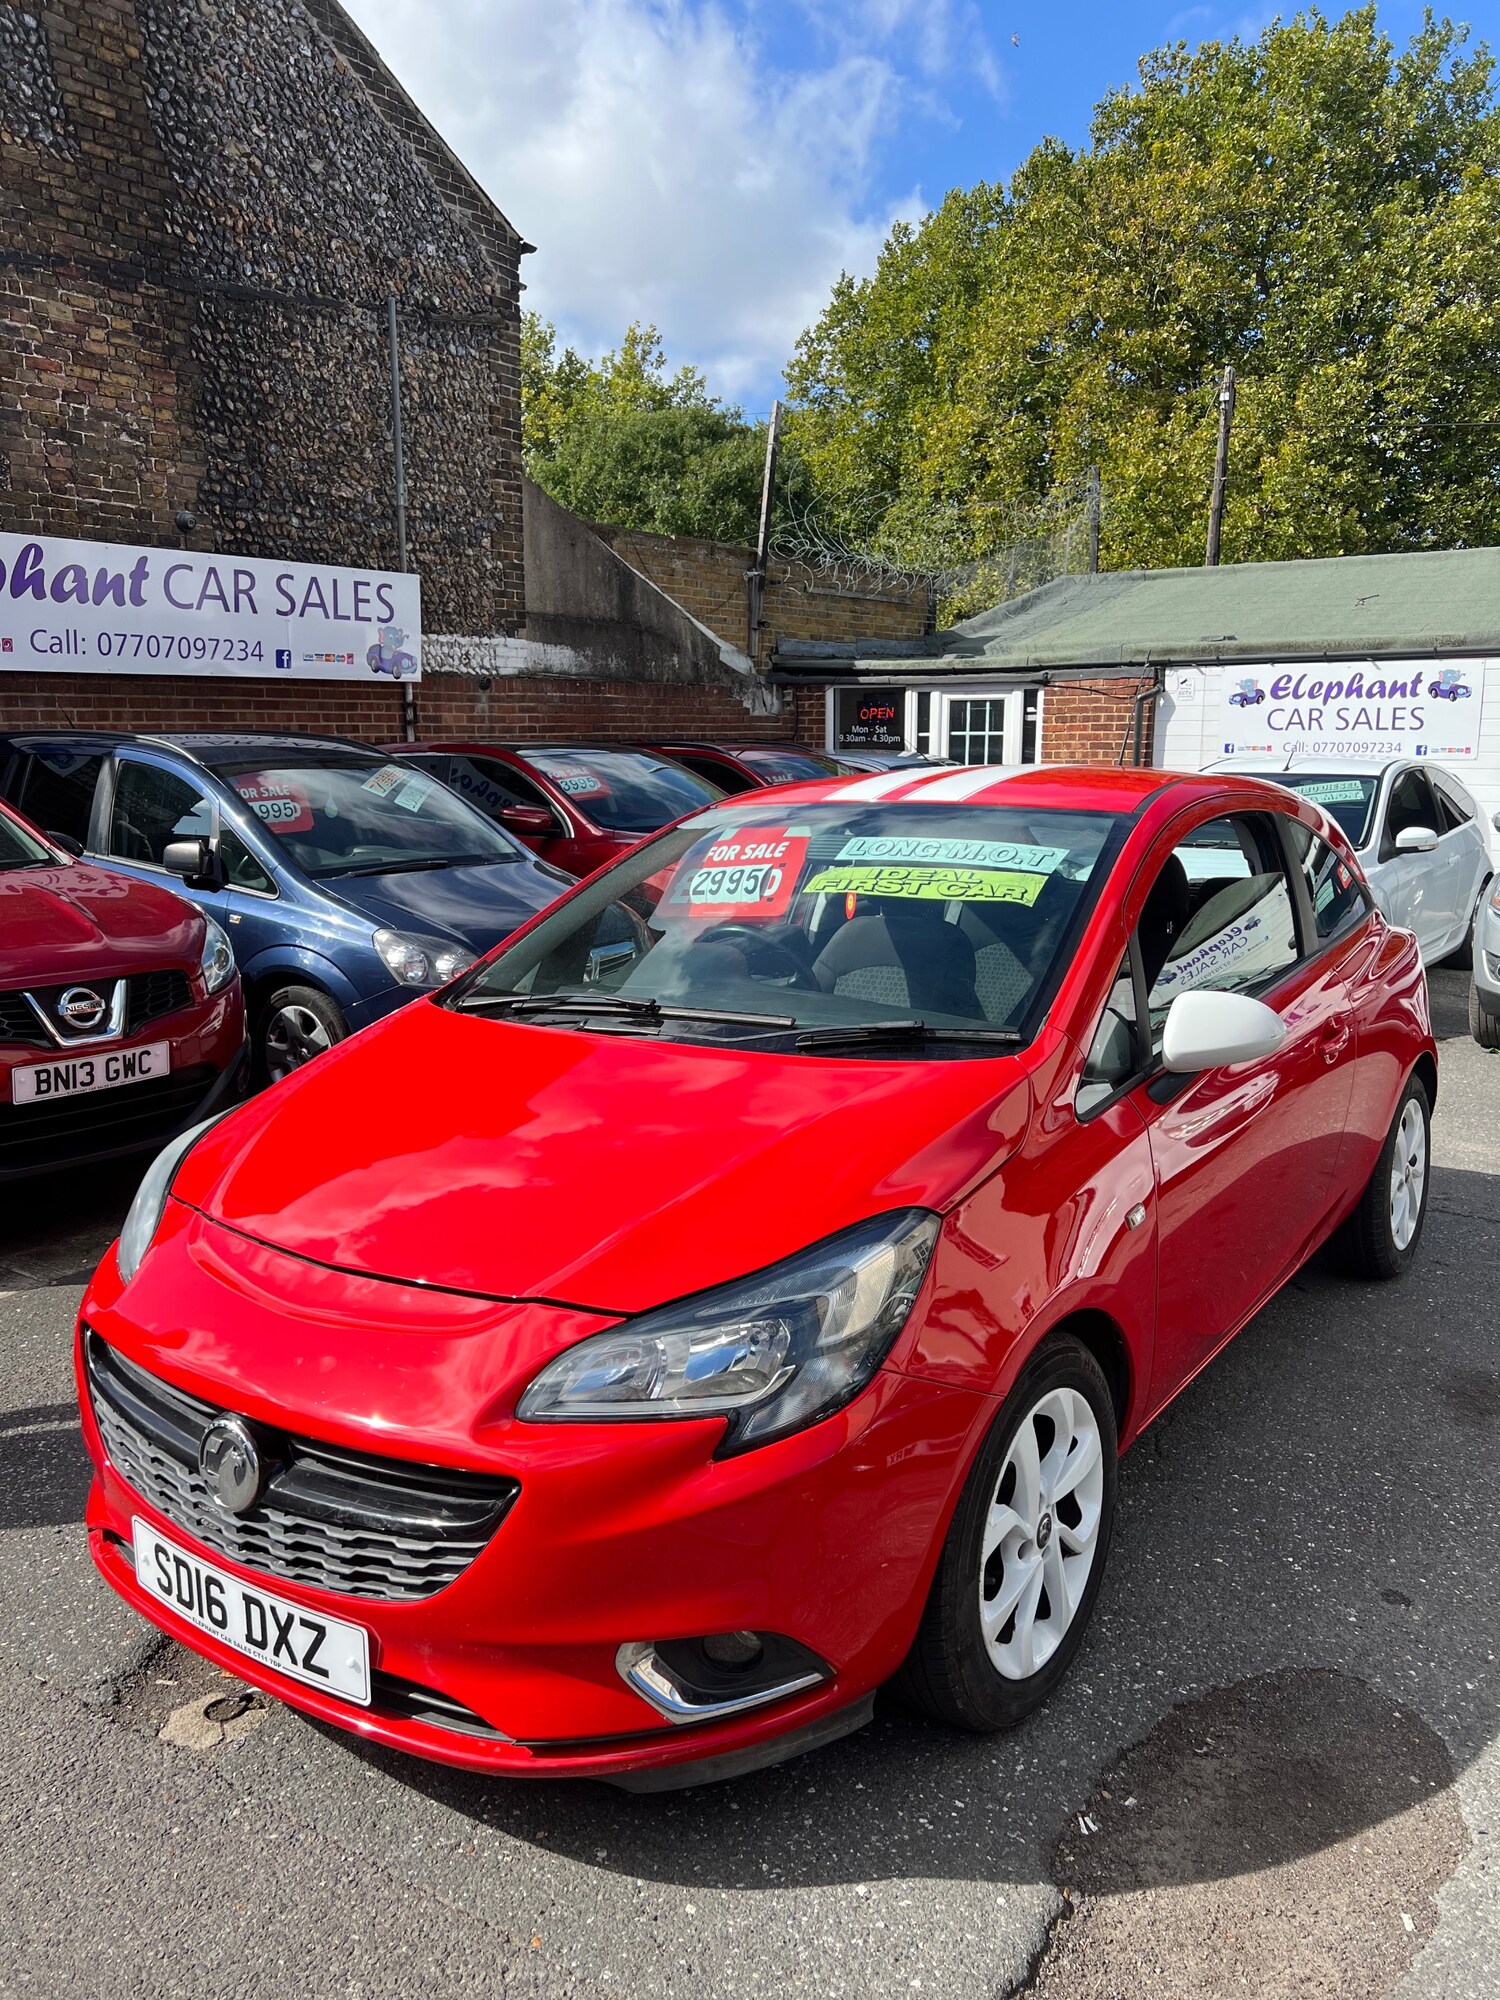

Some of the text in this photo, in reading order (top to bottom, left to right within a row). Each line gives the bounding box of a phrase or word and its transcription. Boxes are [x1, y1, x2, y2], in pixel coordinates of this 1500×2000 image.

[0, 543, 395, 623] hant CAR SALES
[29, 628, 264, 662] Call: 07707097234
[1269, 671, 1423, 706] Elephant
[860, 707, 895, 719] OPEN
[1267, 707, 1425, 731] CAR SALES
[839, 734, 866, 742] 9.30am
[872, 734, 901, 744] 4.30pm
[851, 725, 869, 733] Mon
[875, 725, 888, 733] Sat
[1313, 741, 1402, 753] 07707097234
[560, 777, 596, 791] 3995
[773, 774, 794, 782] SALE
[235, 785, 290, 798] OR SALE
[704, 842, 791, 862] FOR SALE
[848, 838, 1056, 867] LONG M.O.T
[865, 868, 983, 884] IDEAL
[815, 879, 1029, 900] FIRST CAR
[65, 1002, 103, 1012] NISSAN
[35, 1050, 152, 1095] BN13 GWC
[154, 1543, 330, 1679] SD16 DXZ
[192, 1617, 220, 1637] ELEPHANT
[220, 1633, 232, 1644] CAR
[233, 1640, 252, 1655] SALES
